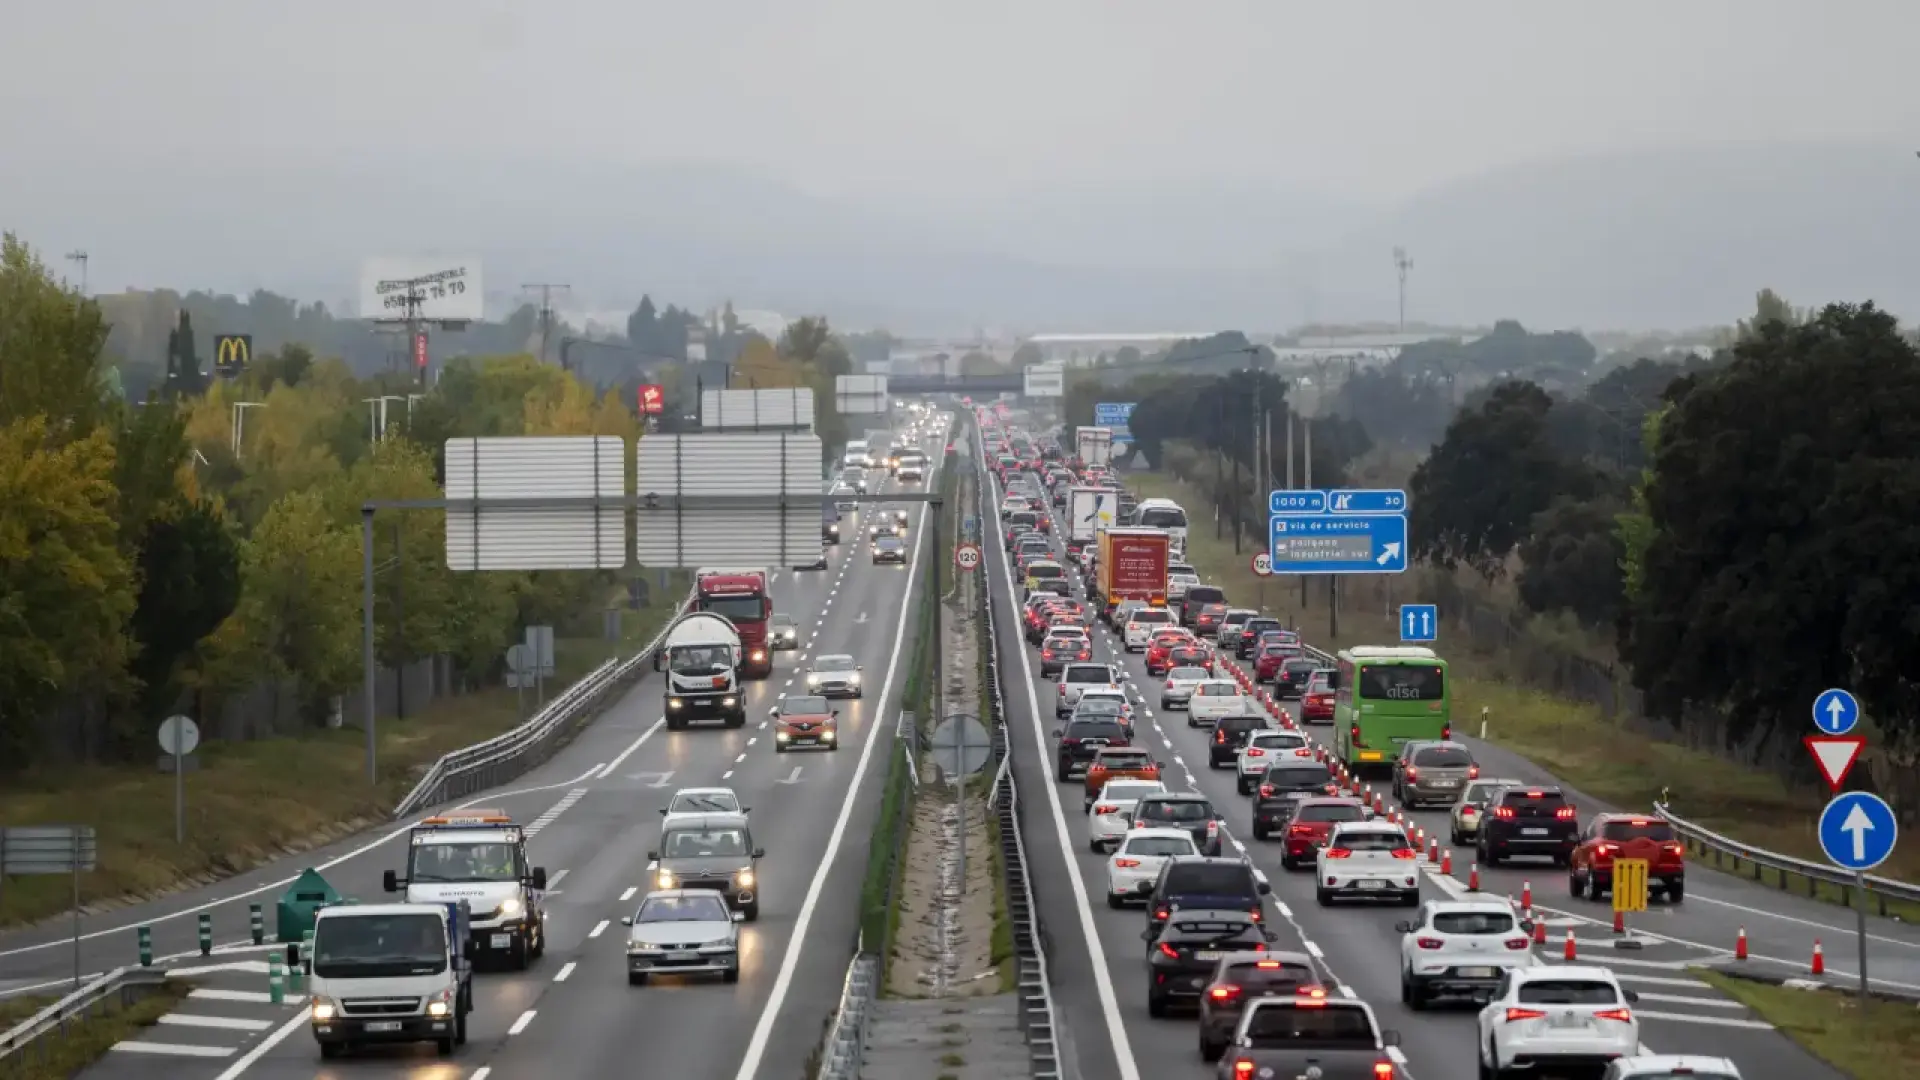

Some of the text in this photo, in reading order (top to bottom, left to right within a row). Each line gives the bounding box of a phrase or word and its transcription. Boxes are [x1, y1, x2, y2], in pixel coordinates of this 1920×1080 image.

[1275, 497, 1306, 506] 1000
[1385, 496, 1401, 505] 30
[1310, 521, 1322, 529] de
[1325, 521, 1370, 529] servicio
[959, 552, 977, 562] 120
[1386, 683, 1420, 698] alsa
